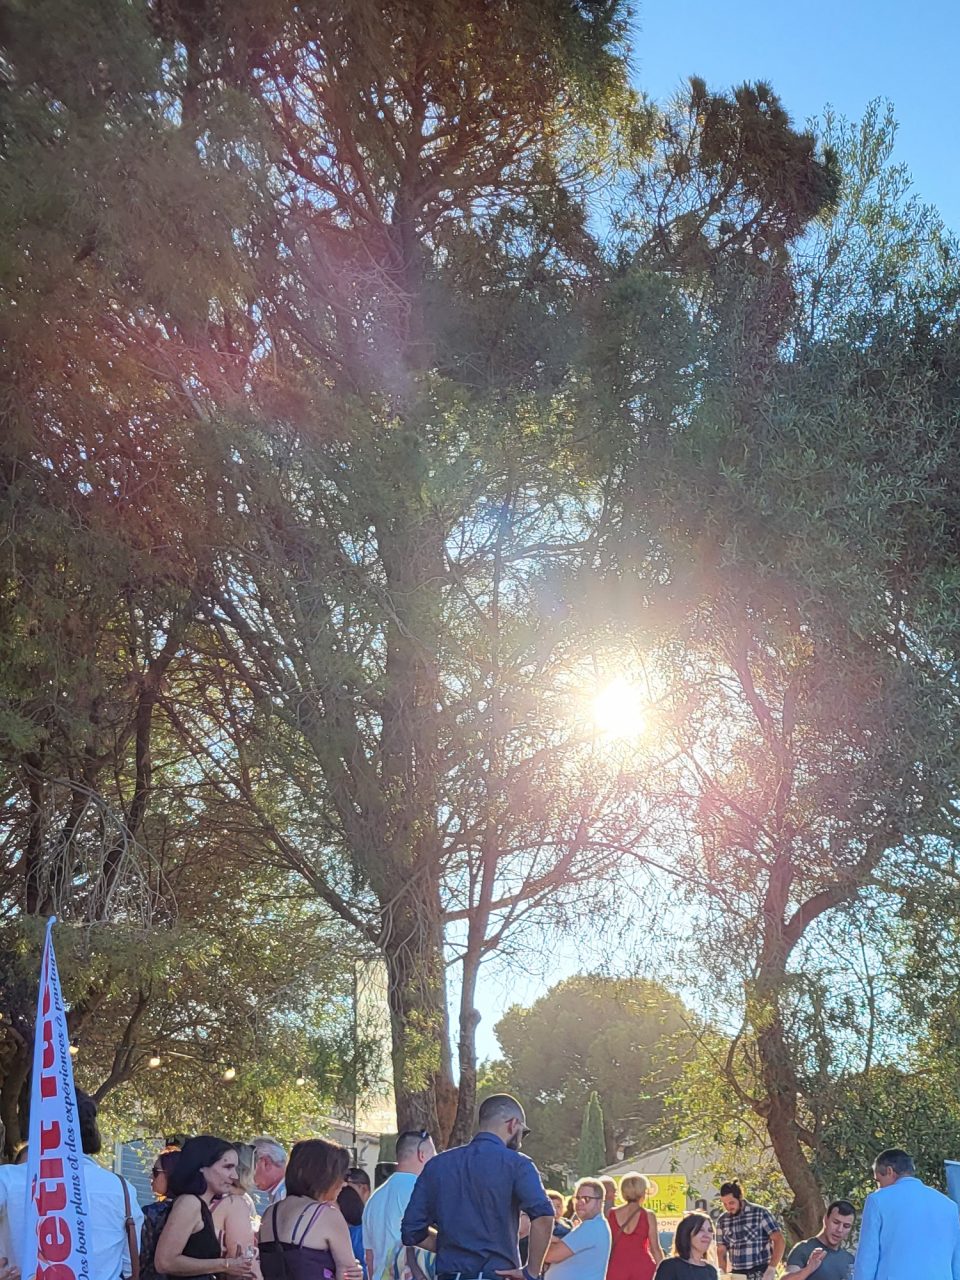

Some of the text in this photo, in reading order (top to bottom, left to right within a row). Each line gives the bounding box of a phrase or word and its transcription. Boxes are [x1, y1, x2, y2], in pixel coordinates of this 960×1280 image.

[58, 1031, 76, 1123] expériences
[64, 1126, 77, 1152] des
[67, 1154, 79, 1169] et
[72, 1172, 88, 1216] plans
[75, 1217, 88, 1255] bons
